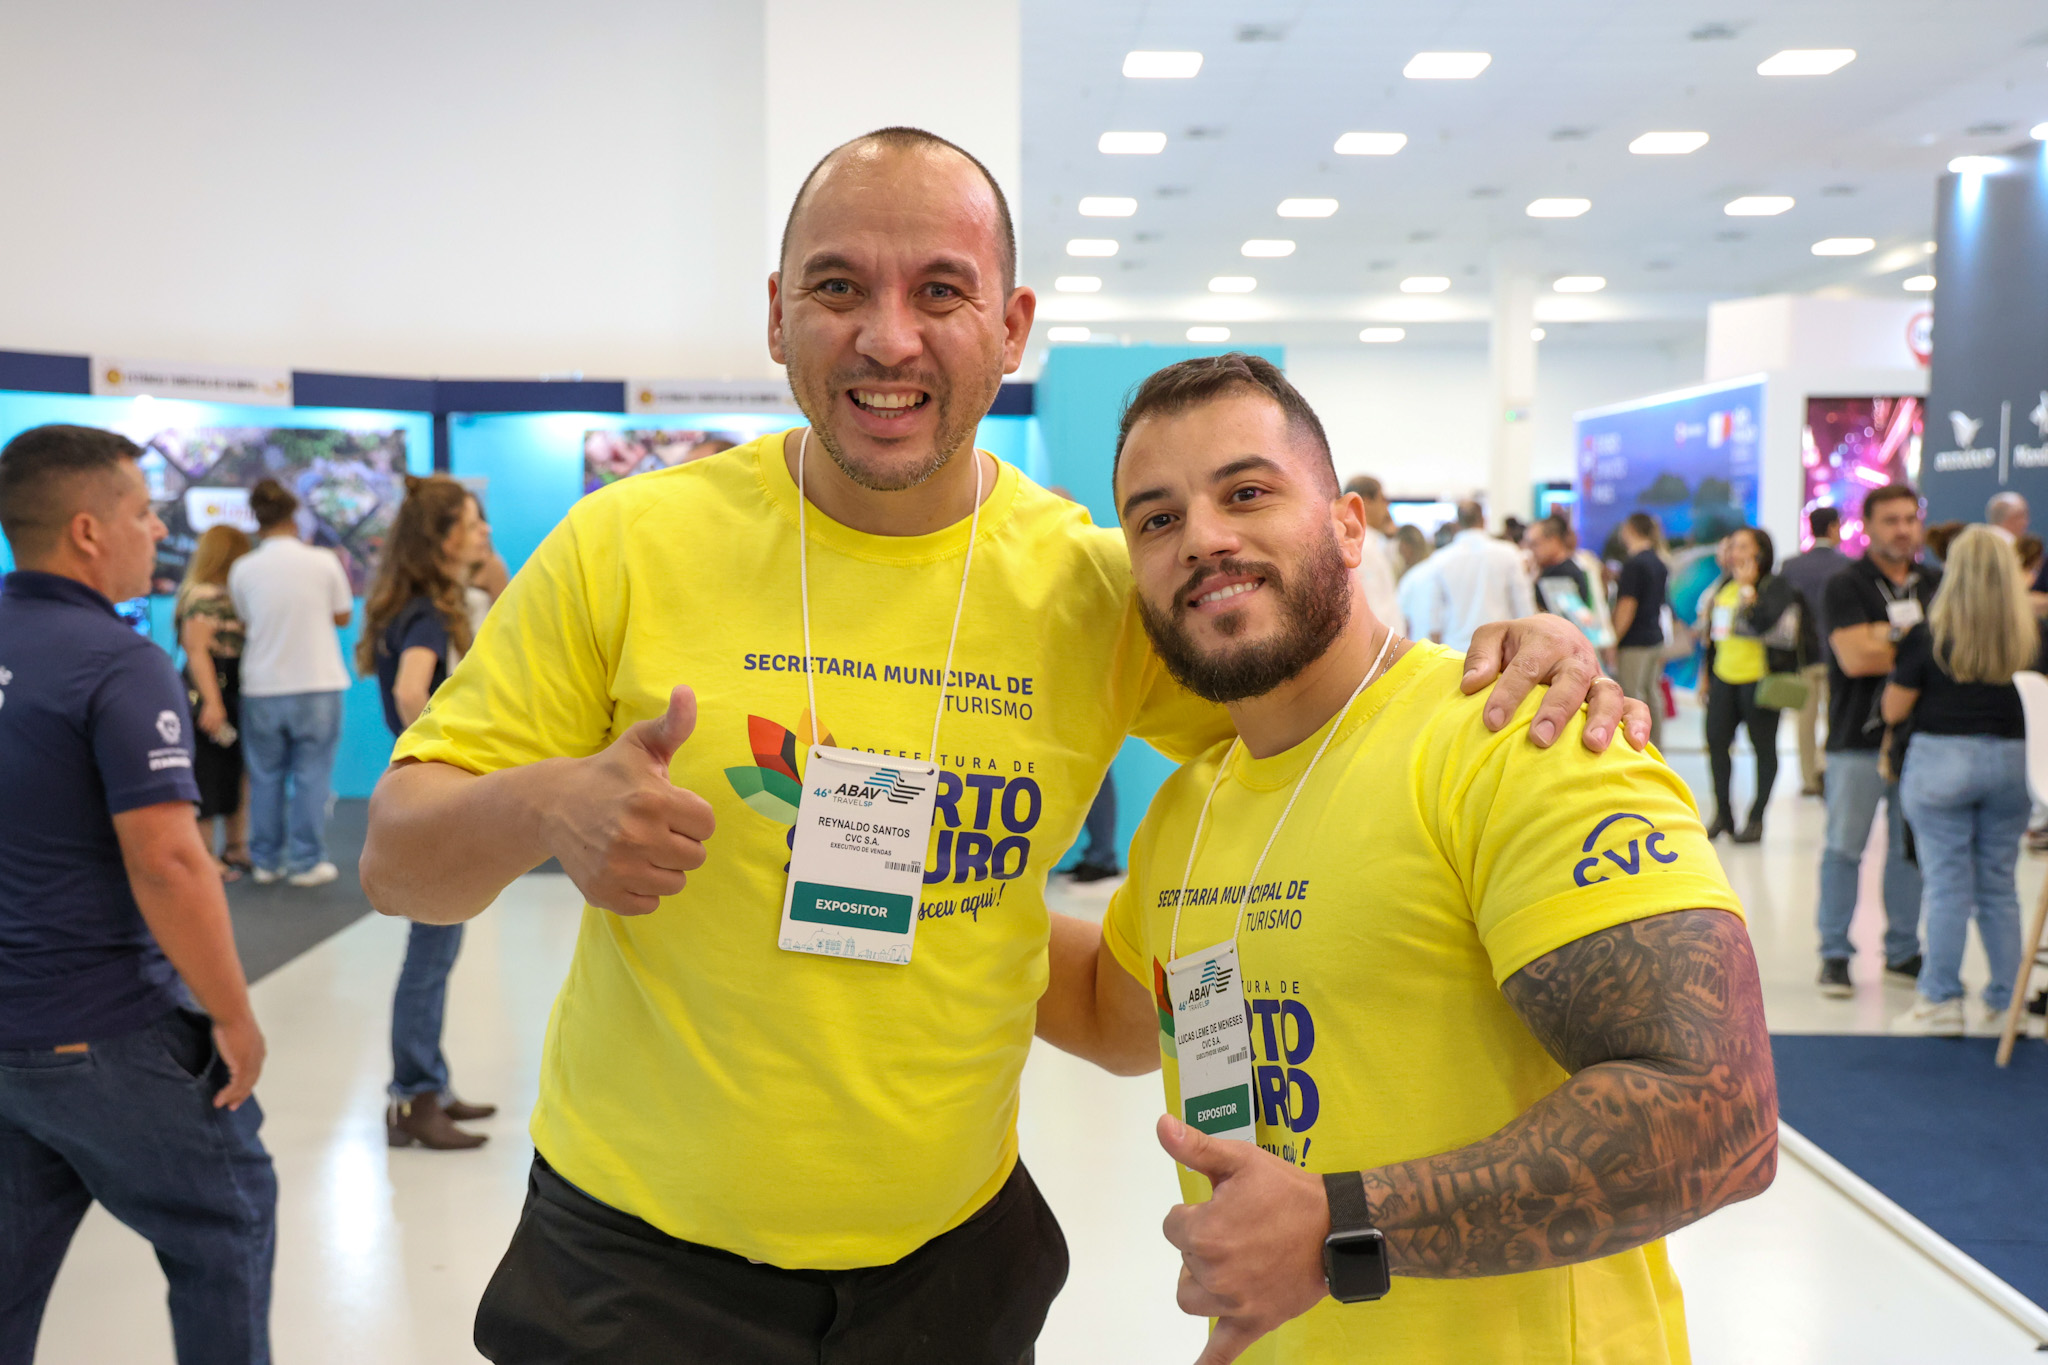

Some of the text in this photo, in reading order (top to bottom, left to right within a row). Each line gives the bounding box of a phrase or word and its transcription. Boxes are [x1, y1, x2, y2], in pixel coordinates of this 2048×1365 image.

[743, 653, 1033, 695] SECRETARIA MUNICIPAL DE
[945, 695, 1033, 720] TURISMO
[1014, 760, 1035, 773] DE
[834, 783, 881, 800] ABAV
[931, 770, 1042, 834] RTO
[818, 816, 910, 838] REYNALDO SANTOS
[830, 842, 861, 852] EXECUTIVO
[870, 848, 892, 856] VENDAS
[845, 833, 880, 846] CVC S.A.
[1573, 832, 1679, 888] CVC
[1286, 880, 1309, 900] DE
[815, 898, 888, 918] EXPOSITOR
[1246, 909, 1303, 932] TURISMO
[1188, 984, 1211, 1004] ABAV
[1281, 980, 1300, 994] DE
[1178, 1014, 1243, 1045] LUCAS LEME DE MENESES
[1201, 1036, 1221, 1049] CVC S.A.
[1197, 1102, 1237, 1122] EXPOSITOR
